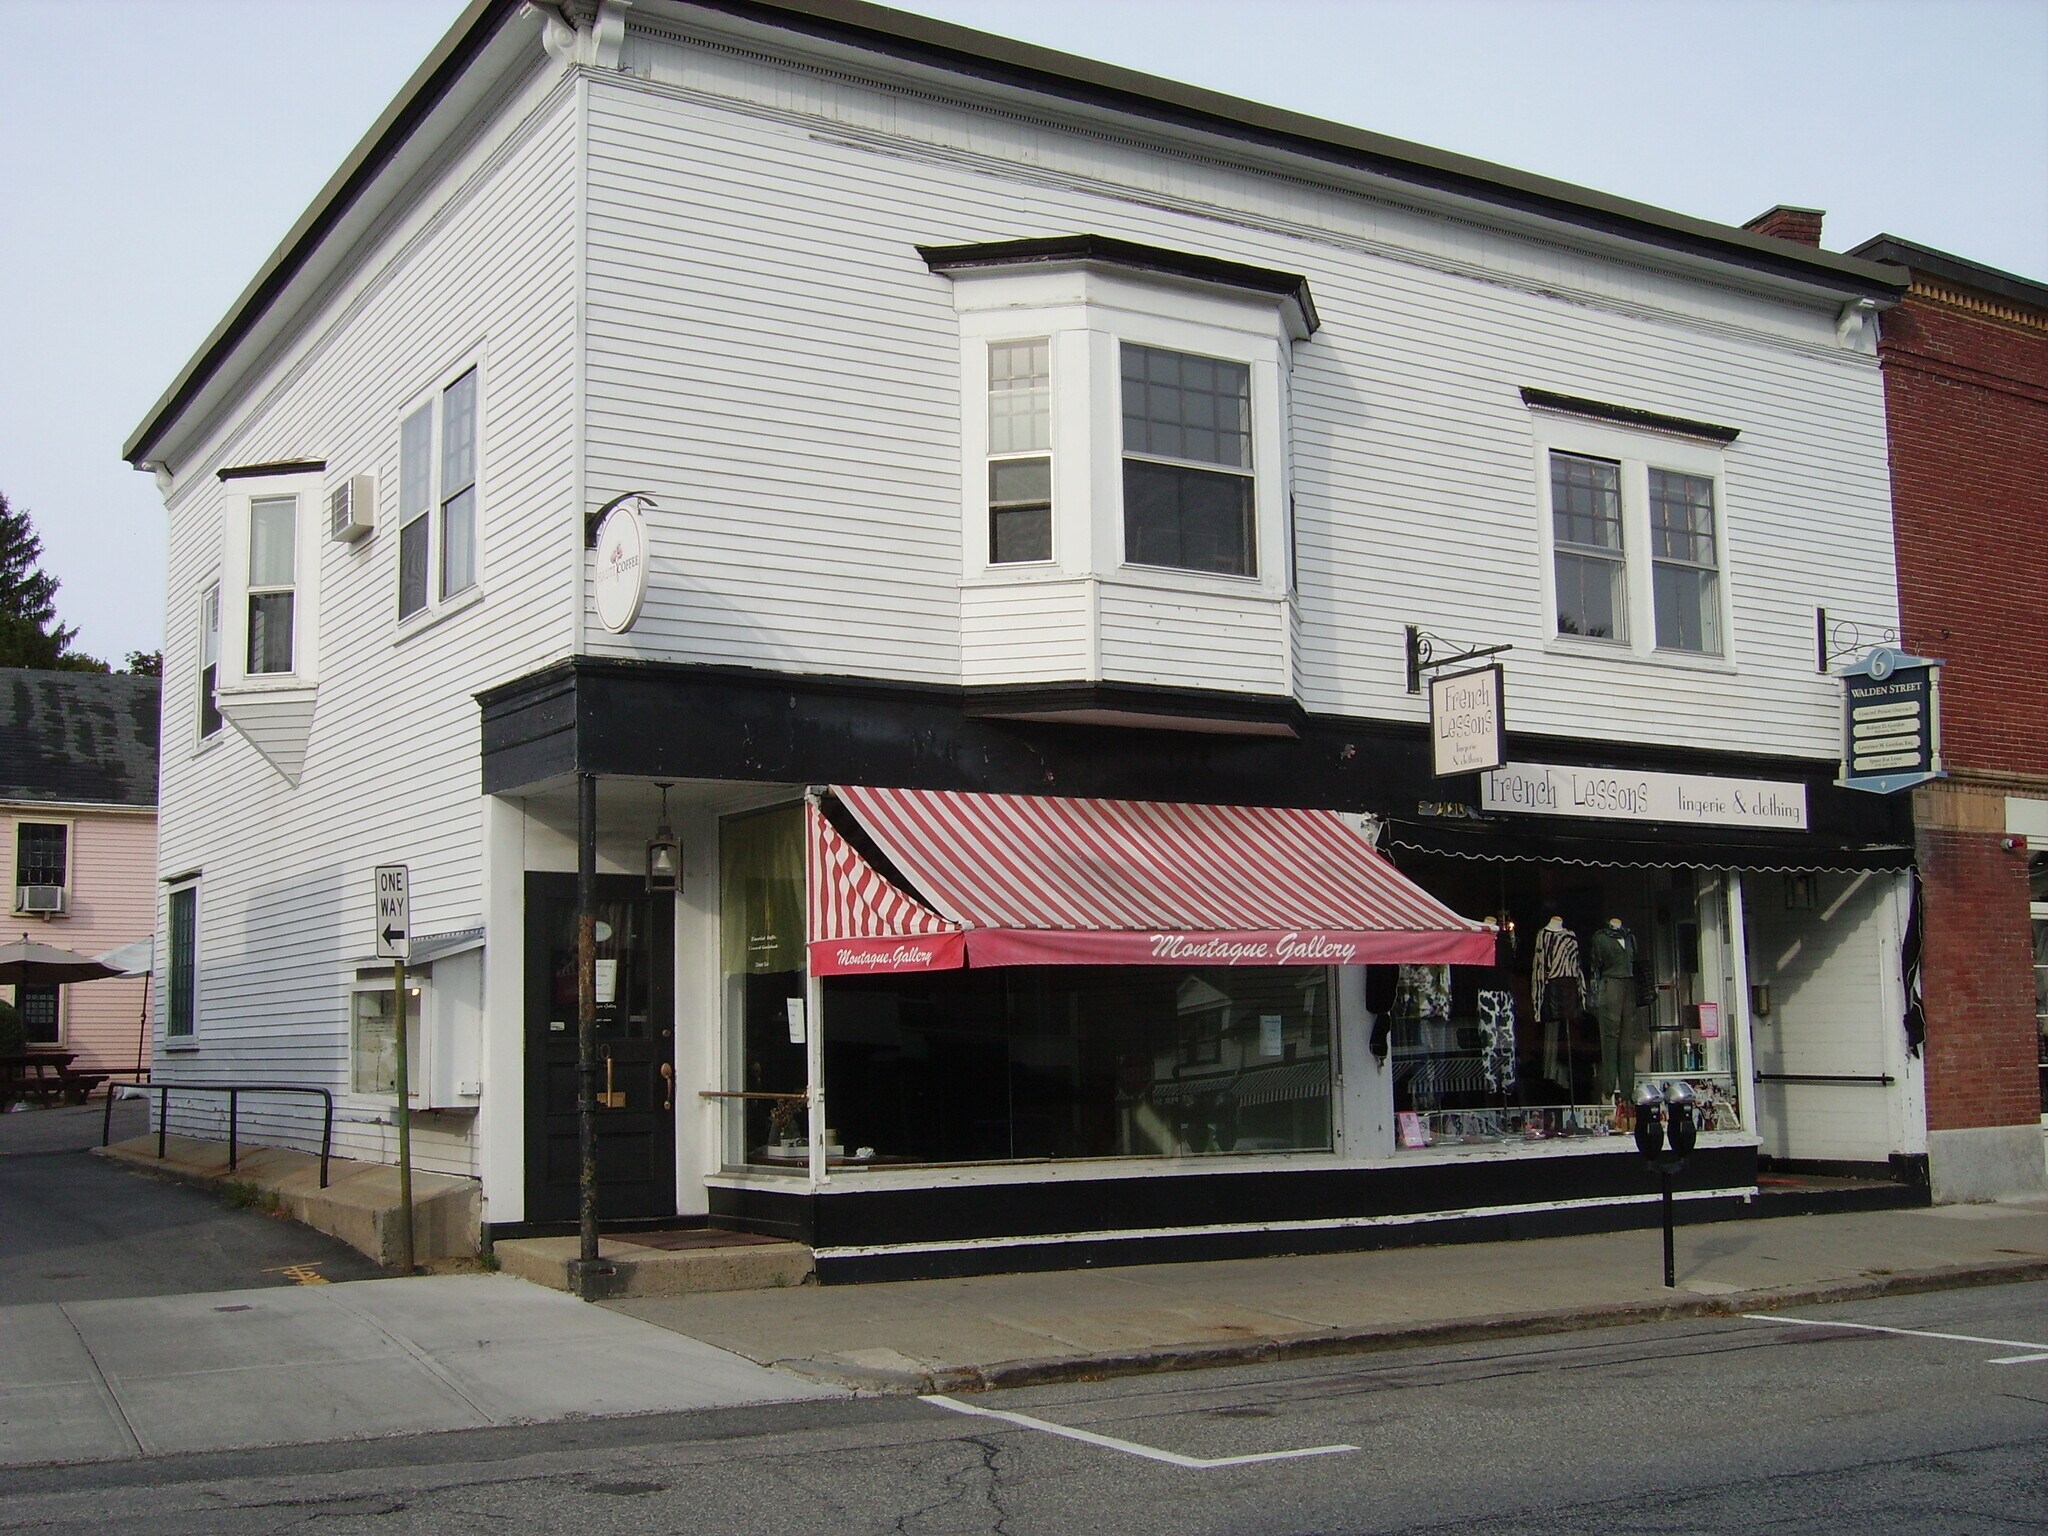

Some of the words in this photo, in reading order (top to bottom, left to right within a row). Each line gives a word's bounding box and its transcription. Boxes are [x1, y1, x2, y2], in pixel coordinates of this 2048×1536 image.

[617, 555, 639, 573] COFFEE
[1871, 651, 1886, 676] 6
[1445, 679, 1490, 712] French
[1851, 686, 1888, 698] WALDEN
[1889, 682, 1922, 693] STREET
[1440, 710, 1493, 739] Lessons
[1490, 769, 1558, 808] French
[1571, 774, 1648, 813] Lessons
[1678, 786, 1726, 817] lingerie
[1733, 789, 1747, 814] &
[1752, 791, 1800, 823] clothing
[381, 872, 403, 891] ONE
[381, 897, 404, 917] WAY
